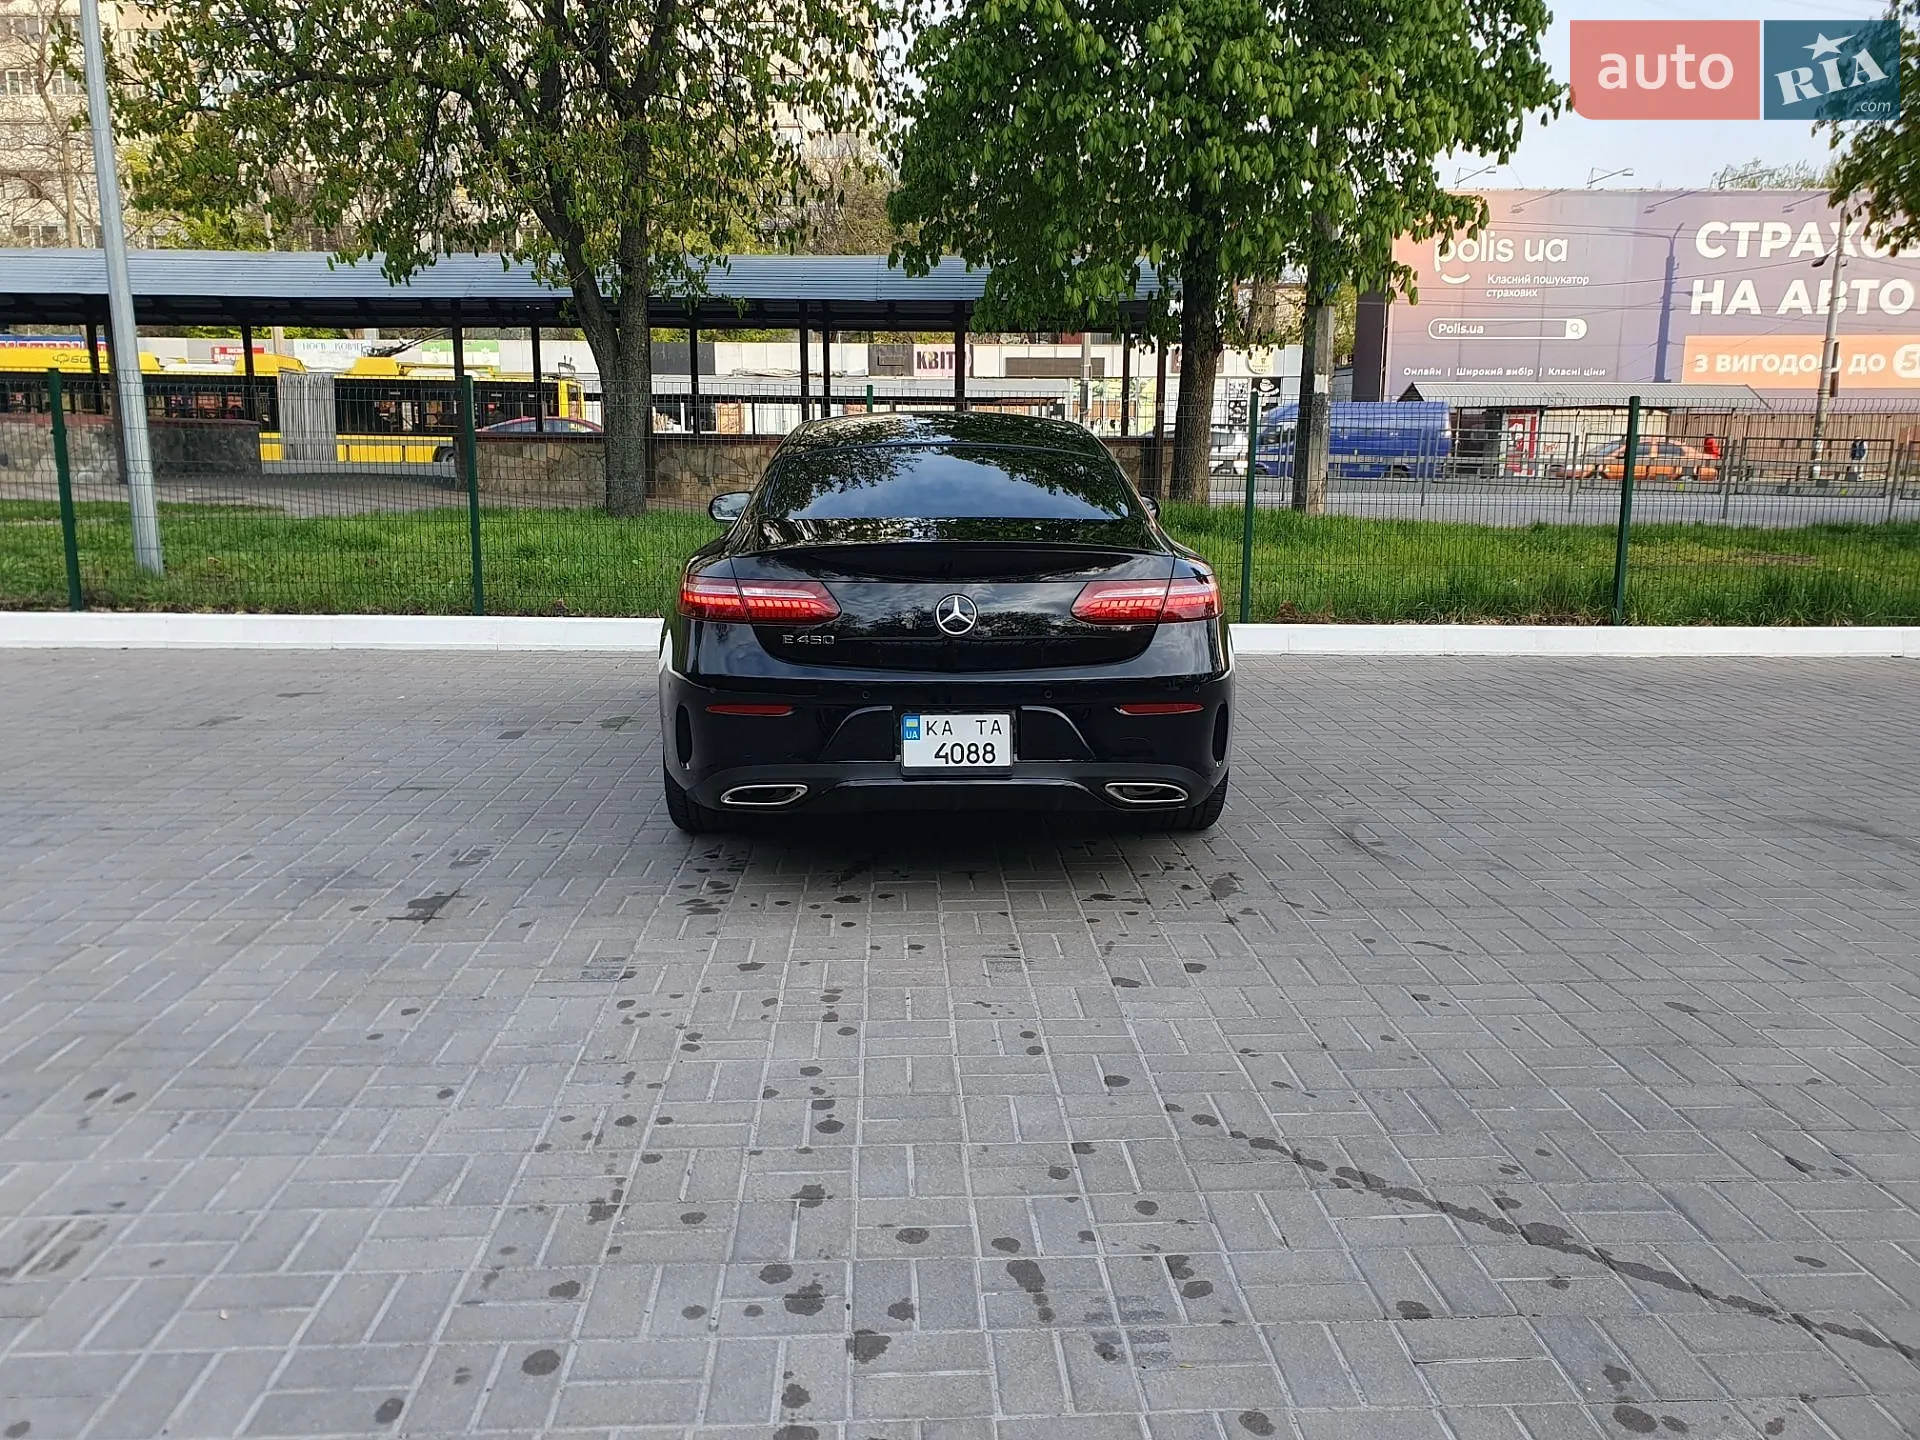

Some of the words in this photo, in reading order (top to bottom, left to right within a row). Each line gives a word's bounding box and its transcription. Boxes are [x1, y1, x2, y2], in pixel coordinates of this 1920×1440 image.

[1434, 230, 1515, 272] polis
[1524, 238, 1568, 262] ua
[1487, 273, 1531, 285] Класний
[1533, 275, 1589, 287] пошукатор
[1486, 288, 1538, 299] страхових
[1690, 279, 1762, 315] НА
[1776, 278, 1915, 315] АВТО
[1438, 323, 1484, 334] Polis.ua
[917, 351, 966, 370] КВІТ
[1848, 354, 1886, 375] ДО
[1403, 367, 1442, 377] Онлайн
[1456, 367, 1503, 378] Широкий
[1506, 367, 1534, 378] вибір
[1548, 367, 1580, 377] Класні
[1584, 368, 1606, 378] ціни
[782, 634, 794, 645] E
[797, 634, 835, 645] 450
[905, 730, 918, 740] UA
[934, 742, 996, 765] 4088
